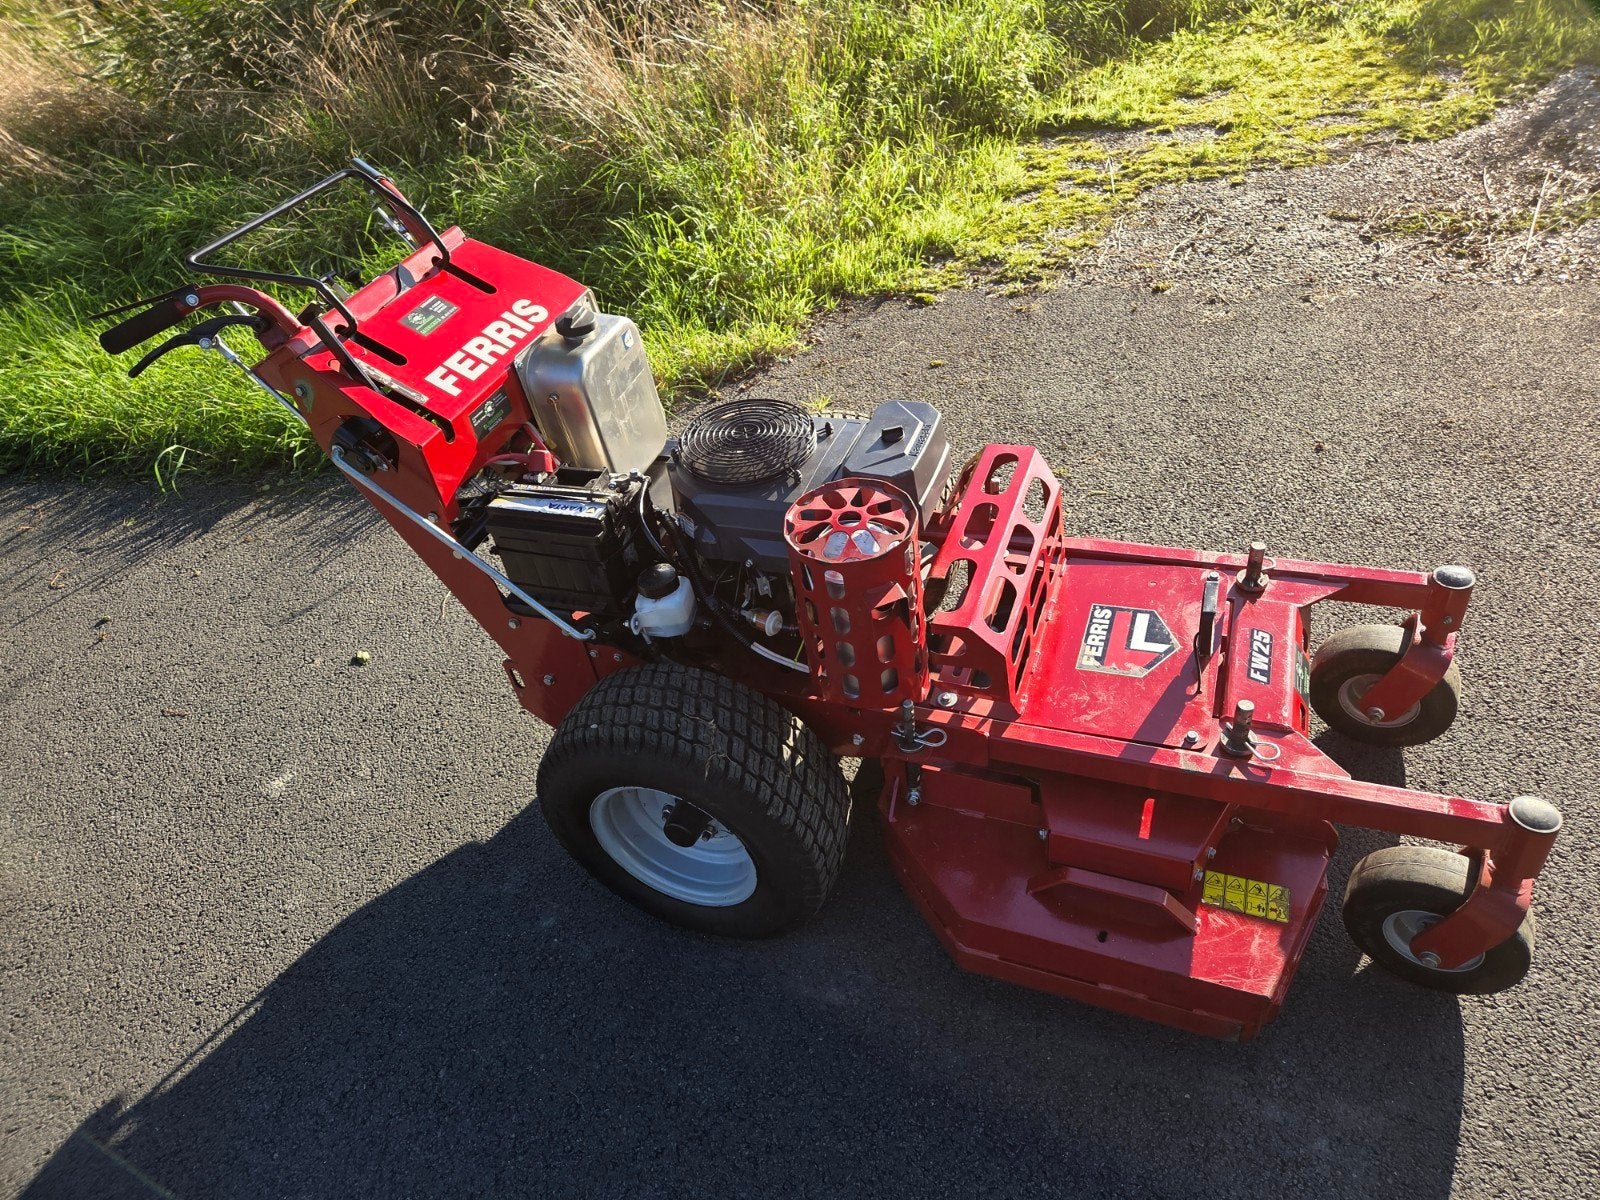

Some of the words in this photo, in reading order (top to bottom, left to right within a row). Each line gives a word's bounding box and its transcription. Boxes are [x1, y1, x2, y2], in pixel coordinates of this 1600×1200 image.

[424, 298, 549, 397] FERRIS
[548, 502, 584, 513] VARTA
[1080, 606, 1113, 666] FERRIS
[1249, 628, 1272, 684] FW25
